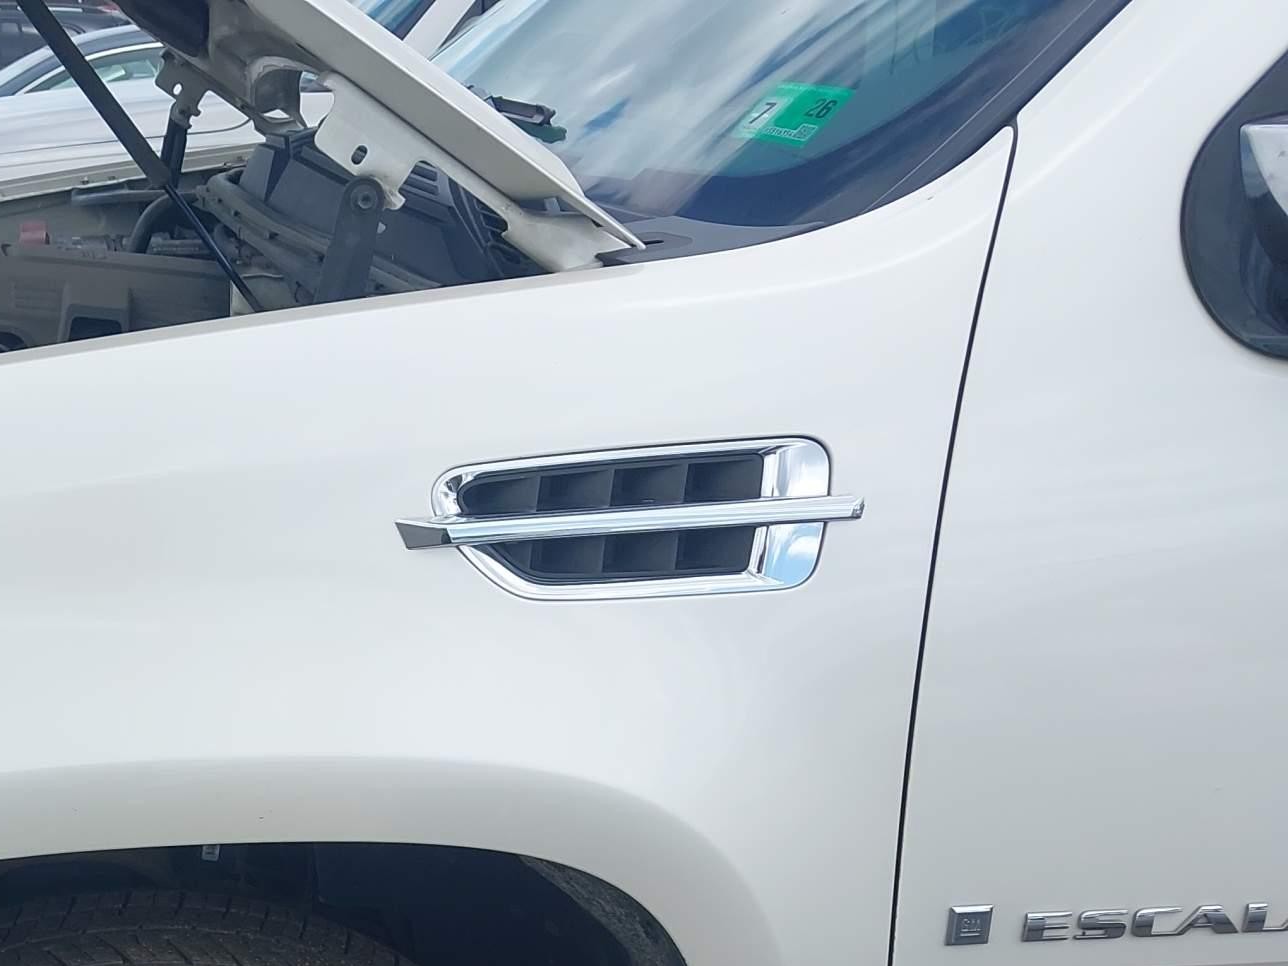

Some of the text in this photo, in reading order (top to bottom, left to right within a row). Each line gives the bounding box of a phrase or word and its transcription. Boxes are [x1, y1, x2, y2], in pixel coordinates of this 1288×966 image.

[749, 98, 838, 124] 7 26
[1021, 902, 1288, 942] ESCAL
